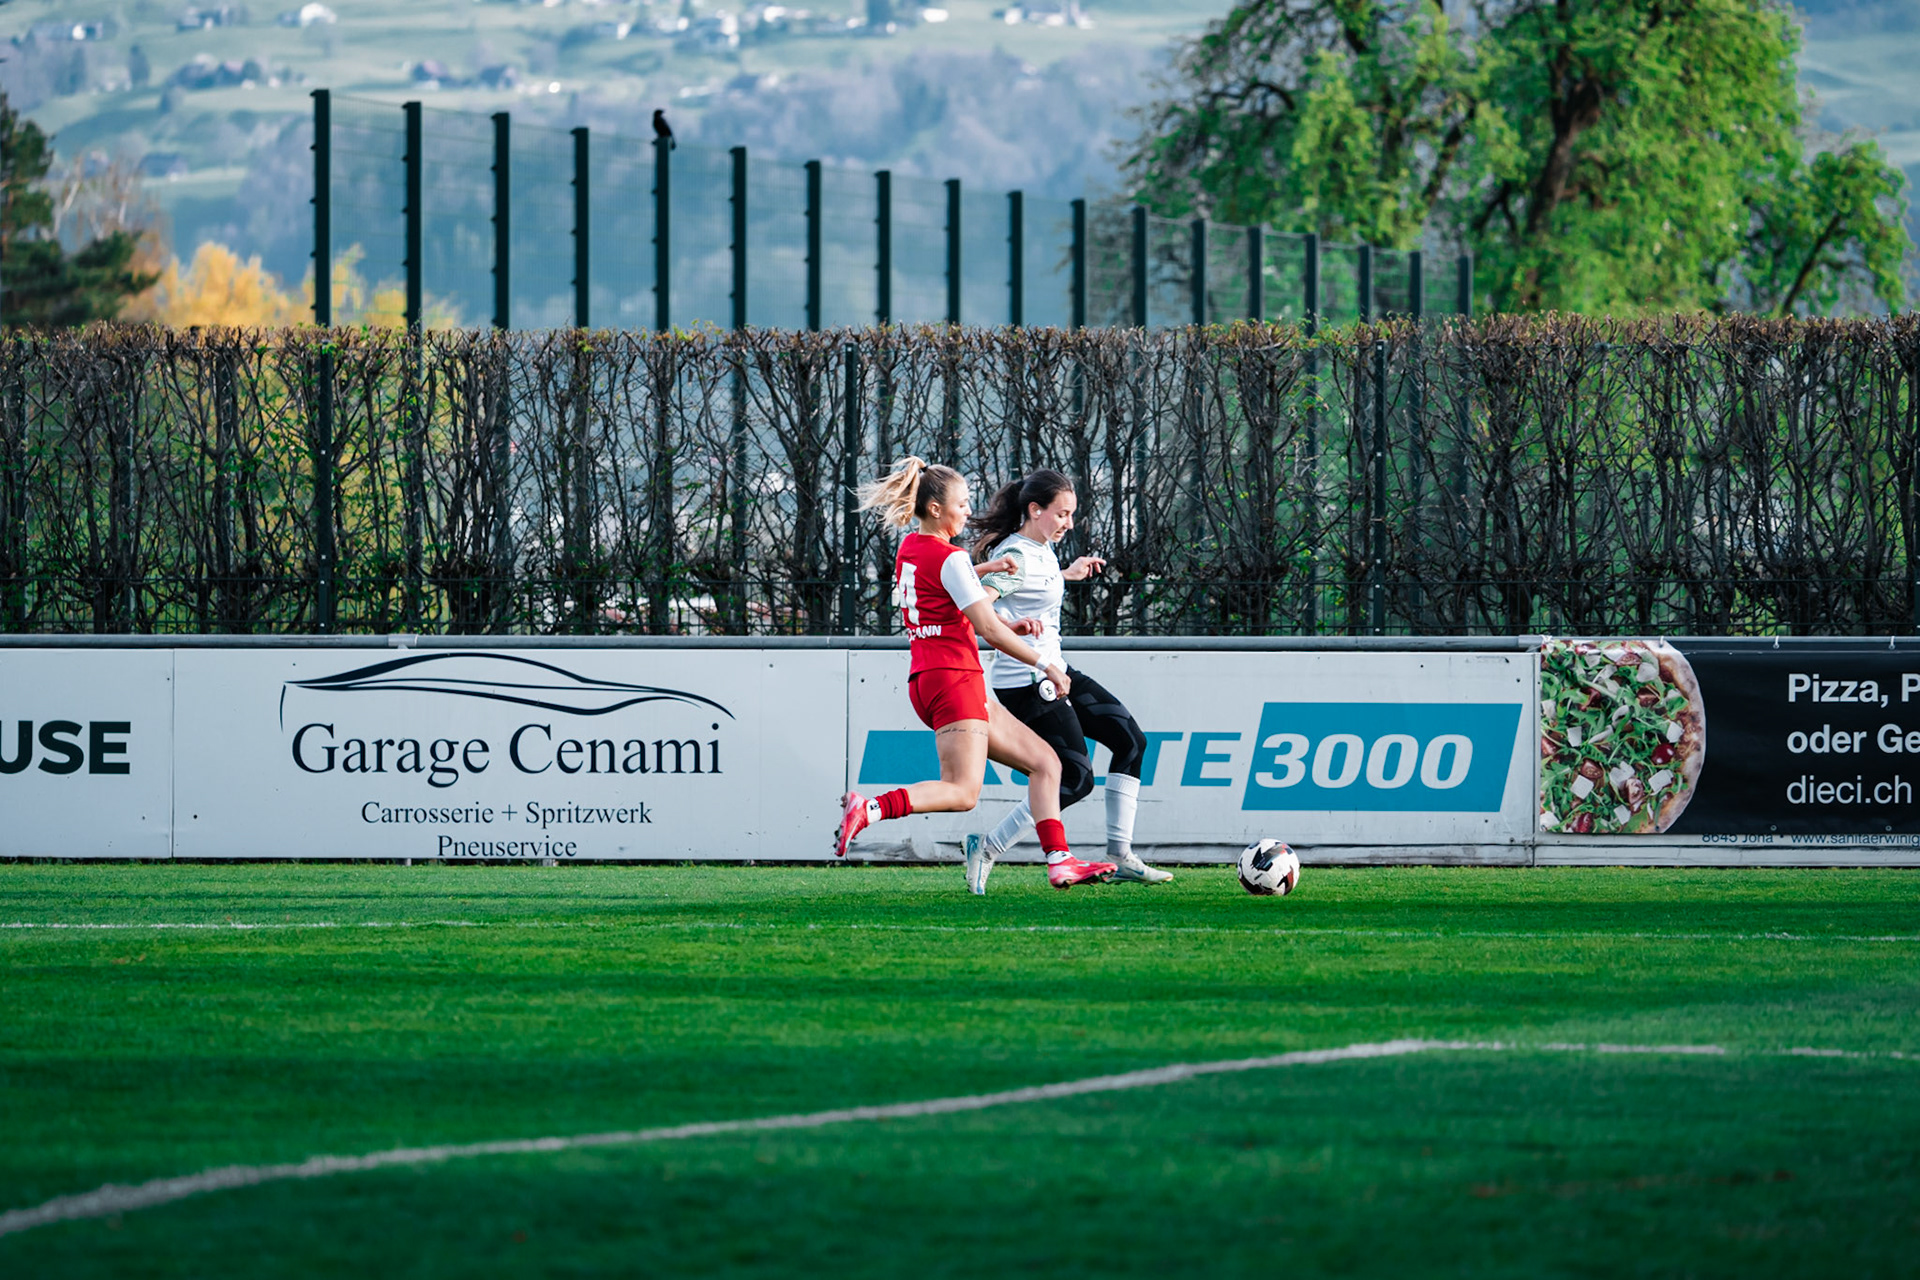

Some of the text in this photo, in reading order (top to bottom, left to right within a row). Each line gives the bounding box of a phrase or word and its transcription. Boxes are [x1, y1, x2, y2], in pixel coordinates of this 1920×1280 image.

[1788, 673, 1889, 708] Pizza,
[0, 720, 131, 775] USE
[1787, 724, 1867, 754] oder
[292, 723, 723, 789] Garage Cenami
[1255, 732, 1474, 790] 3000
[1786, 775, 1912, 804] dieci.ch
[361, 801, 652, 829] Carrosserie + Spritzwerk
[437, 834, 578, 857] Pneuservice
